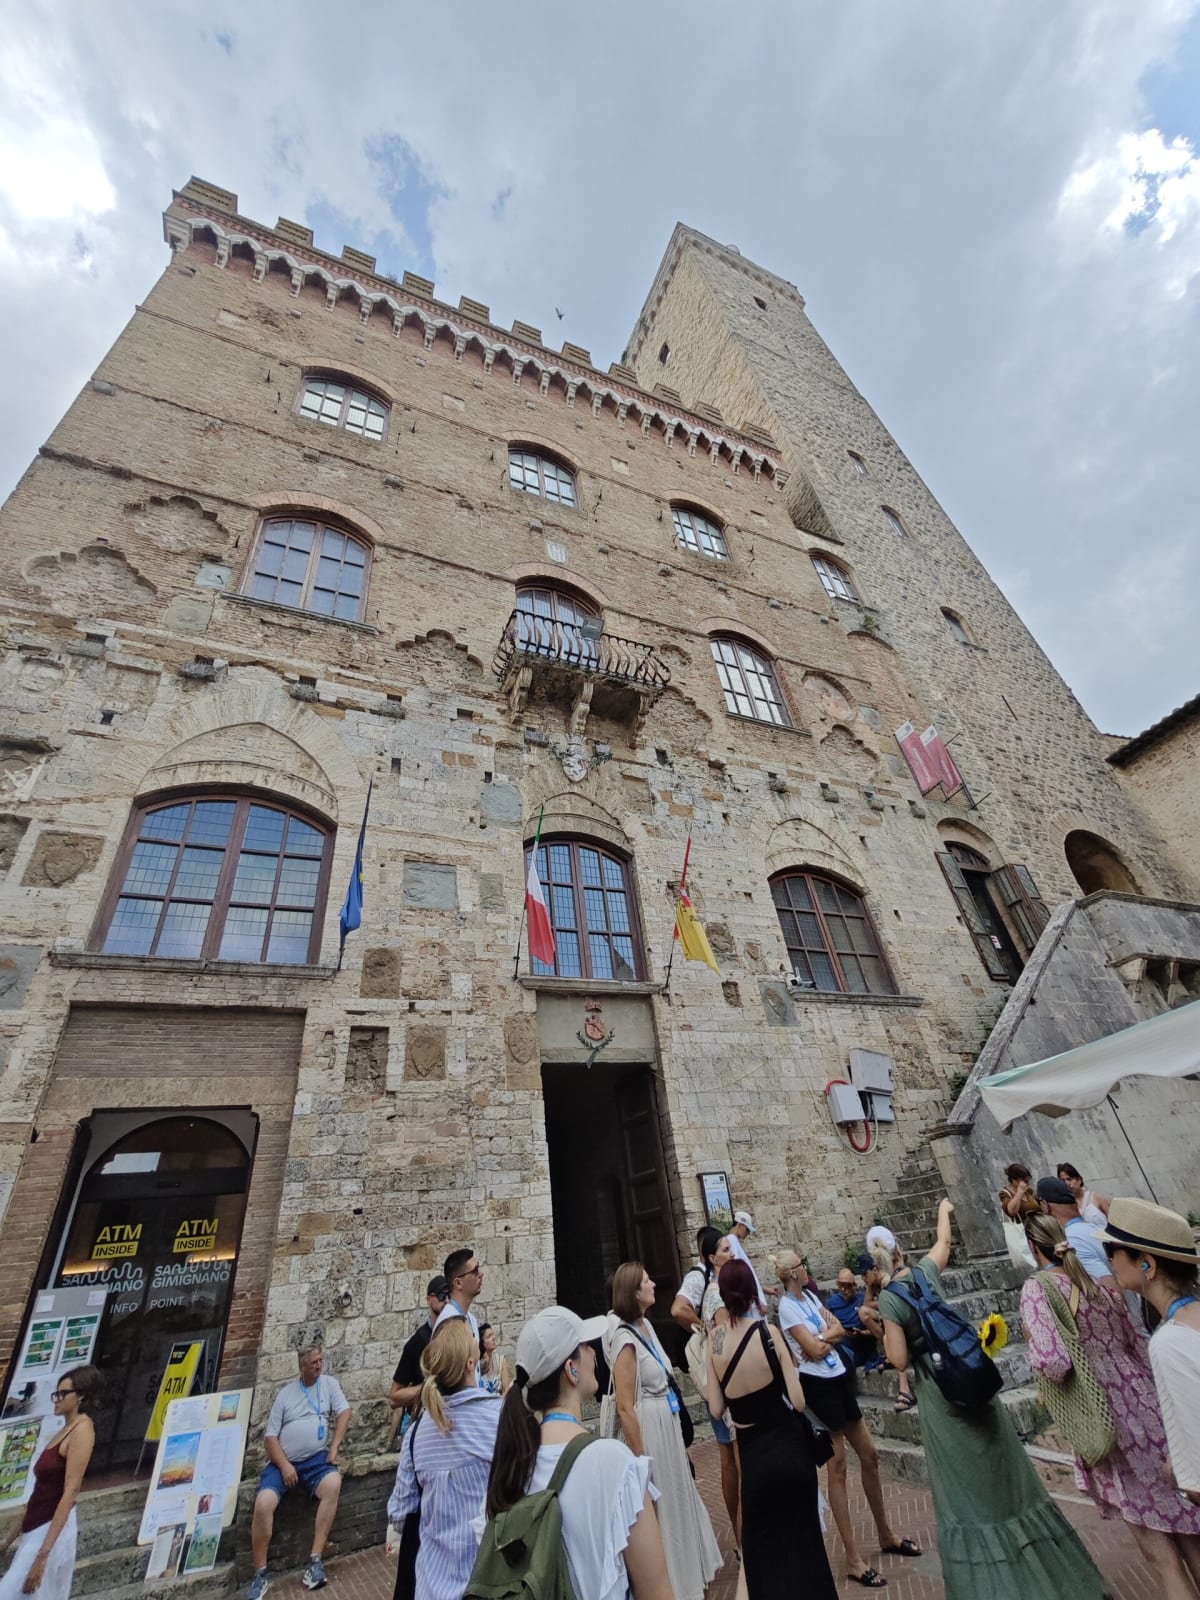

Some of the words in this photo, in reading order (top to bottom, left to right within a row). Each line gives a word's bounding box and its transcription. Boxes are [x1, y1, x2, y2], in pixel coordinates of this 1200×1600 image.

[96, 1224, 143, 1242] ATM
[176, 1218, 219, 1237] ATM
[95, 1244, 136, 1257] INSIDE
[176, 1238, 212, 1250] INSIDE
[152, 1270, 230, 1288] GIMIGNANO
[110, 1302, 138, 1314] INFO
[151, 1296, 185, 1309] POINT
[163, 1376, 187, 1395] ATM
